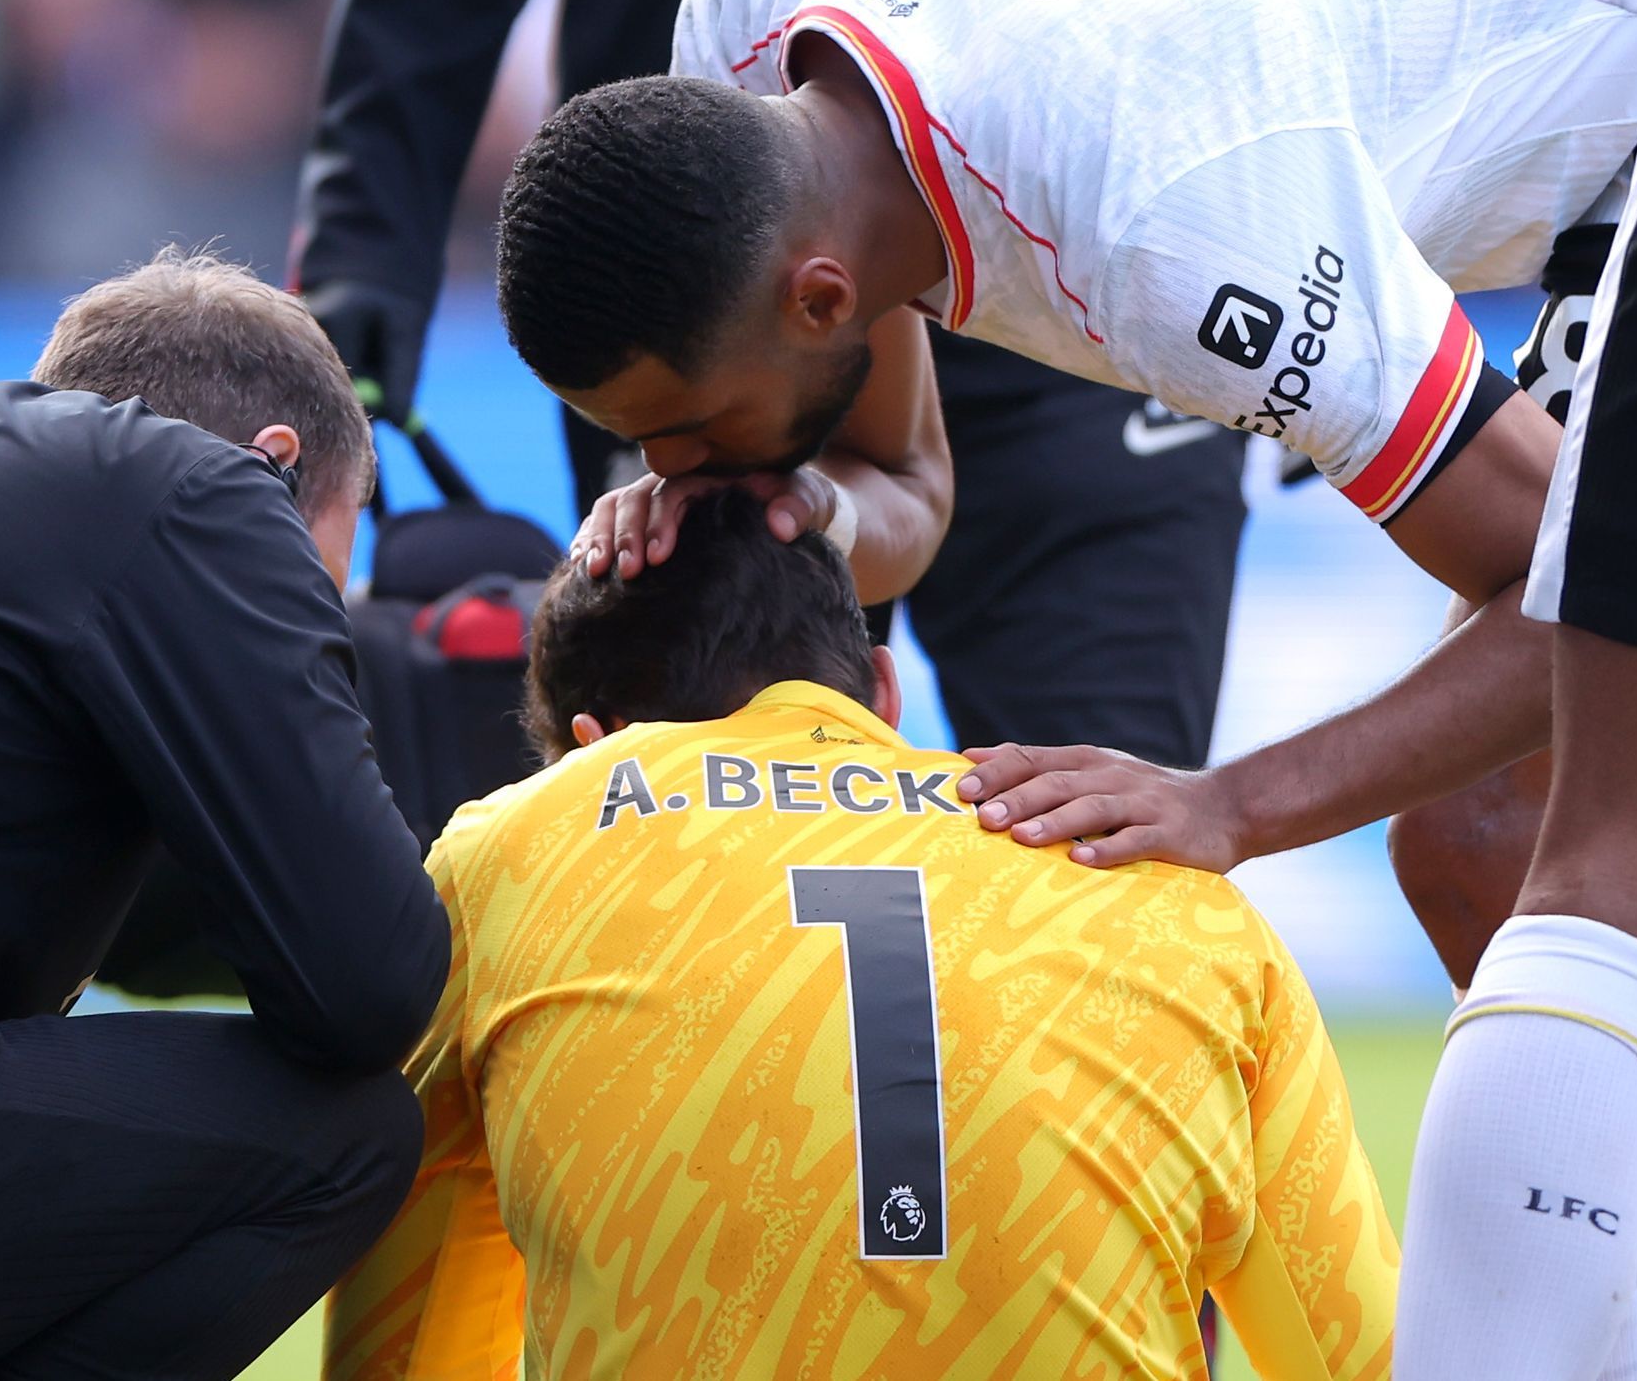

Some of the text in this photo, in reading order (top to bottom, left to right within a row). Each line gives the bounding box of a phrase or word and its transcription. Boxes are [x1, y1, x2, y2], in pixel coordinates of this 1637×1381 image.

[1233, 244, 1344, 439] Expedia
[785, 865, 948, 1261] 1
[1523, 1186, 1619, 1236] LFC
